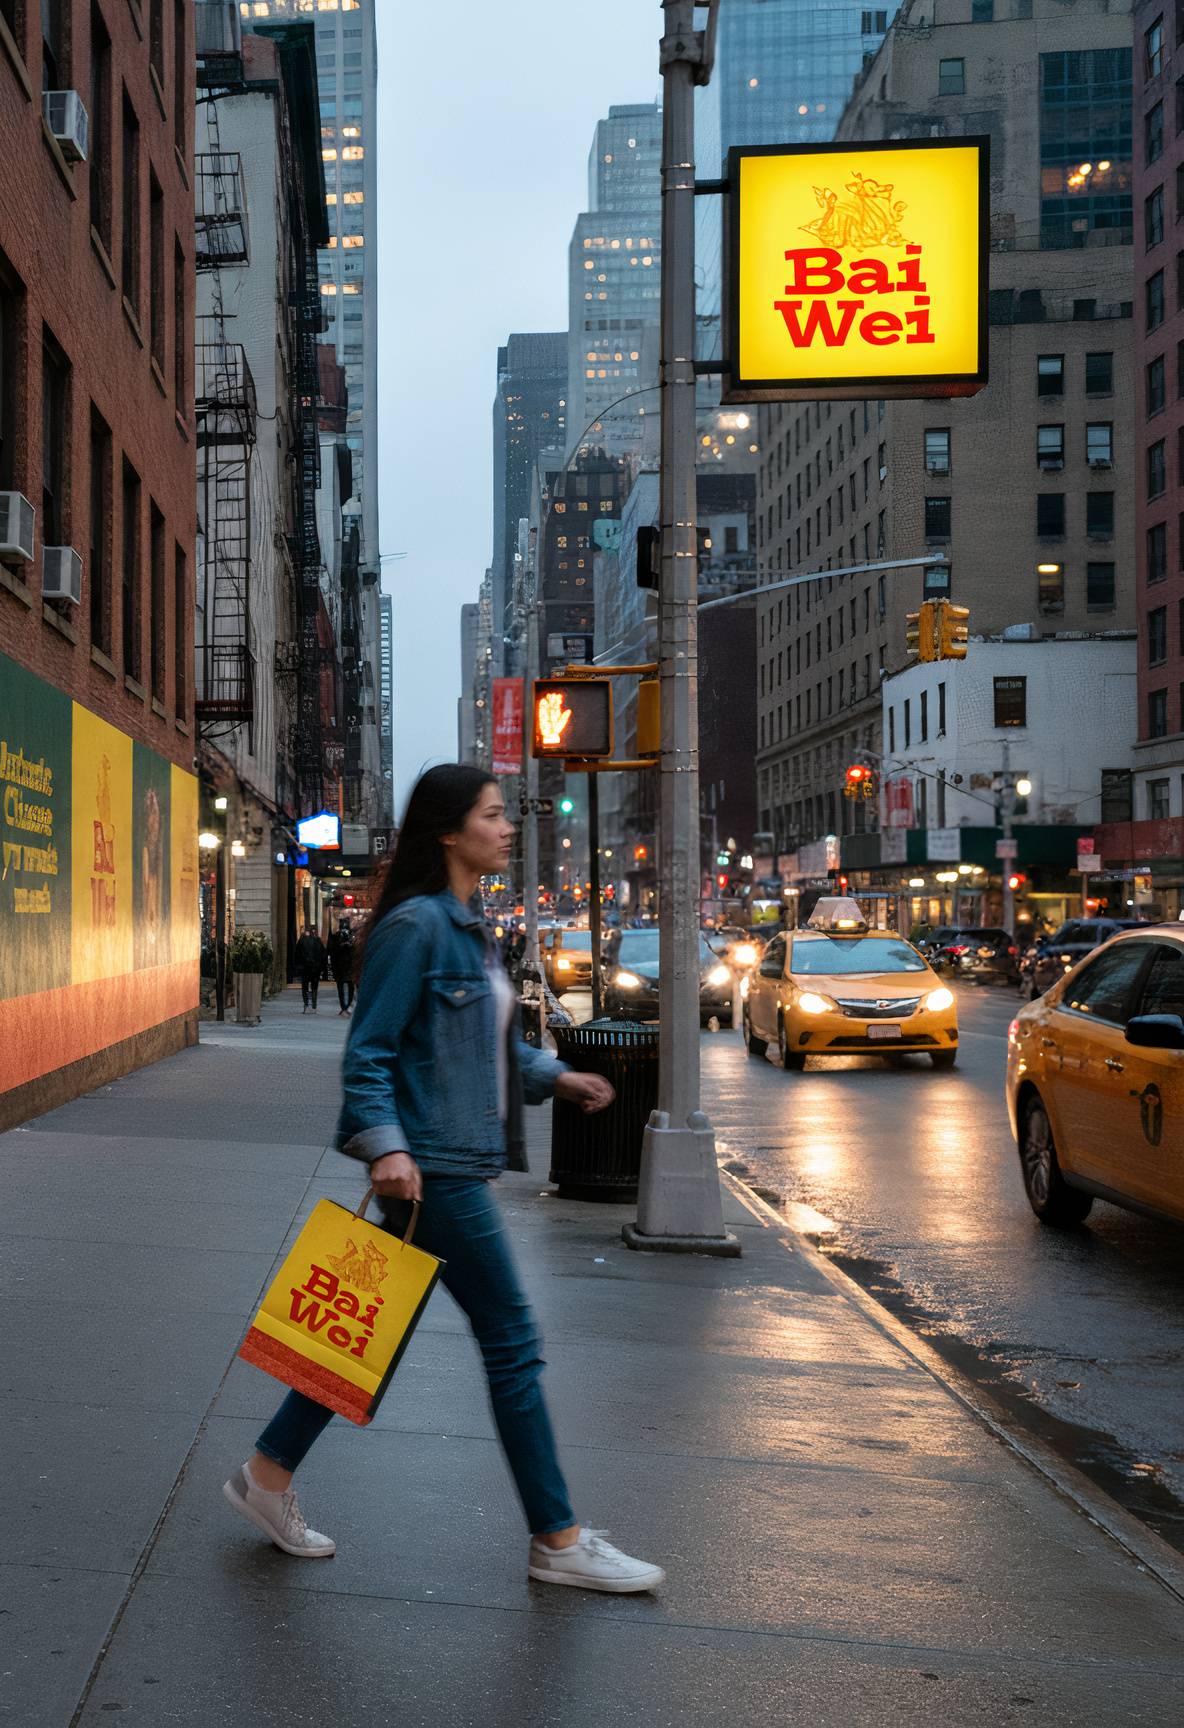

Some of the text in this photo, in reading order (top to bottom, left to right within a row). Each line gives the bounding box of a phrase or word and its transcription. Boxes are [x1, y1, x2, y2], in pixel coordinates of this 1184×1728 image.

[784, 244, 927, 295] Bai
[773, 295, 935, 348] Wei
[301, 1263, 385, 1329] Bai
